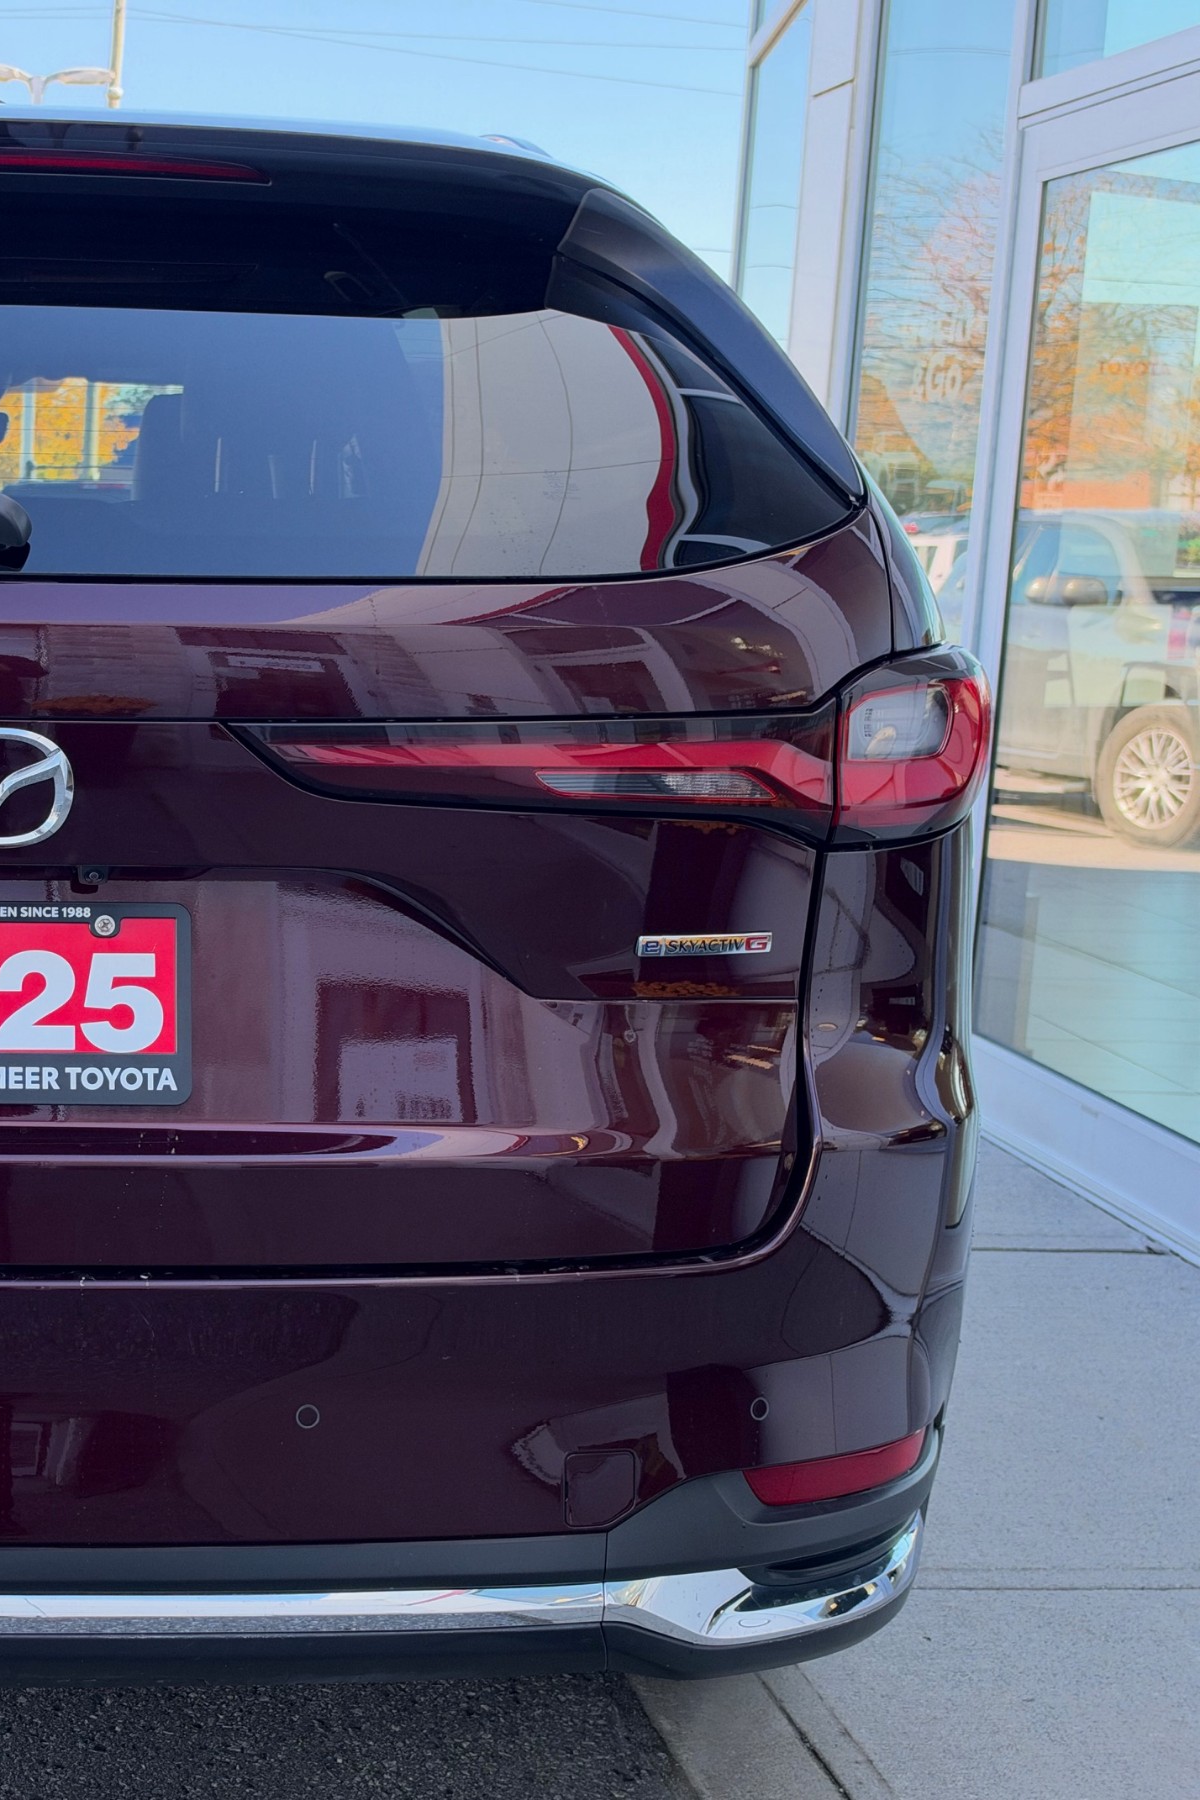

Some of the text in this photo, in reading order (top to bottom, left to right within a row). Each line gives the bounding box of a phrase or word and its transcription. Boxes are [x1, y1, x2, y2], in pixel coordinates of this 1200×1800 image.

[20, 905, 59, 918] SINCE
[61, 906, 91, 919] 1988
[65, 1066, 178, 1091] TOYOTA
